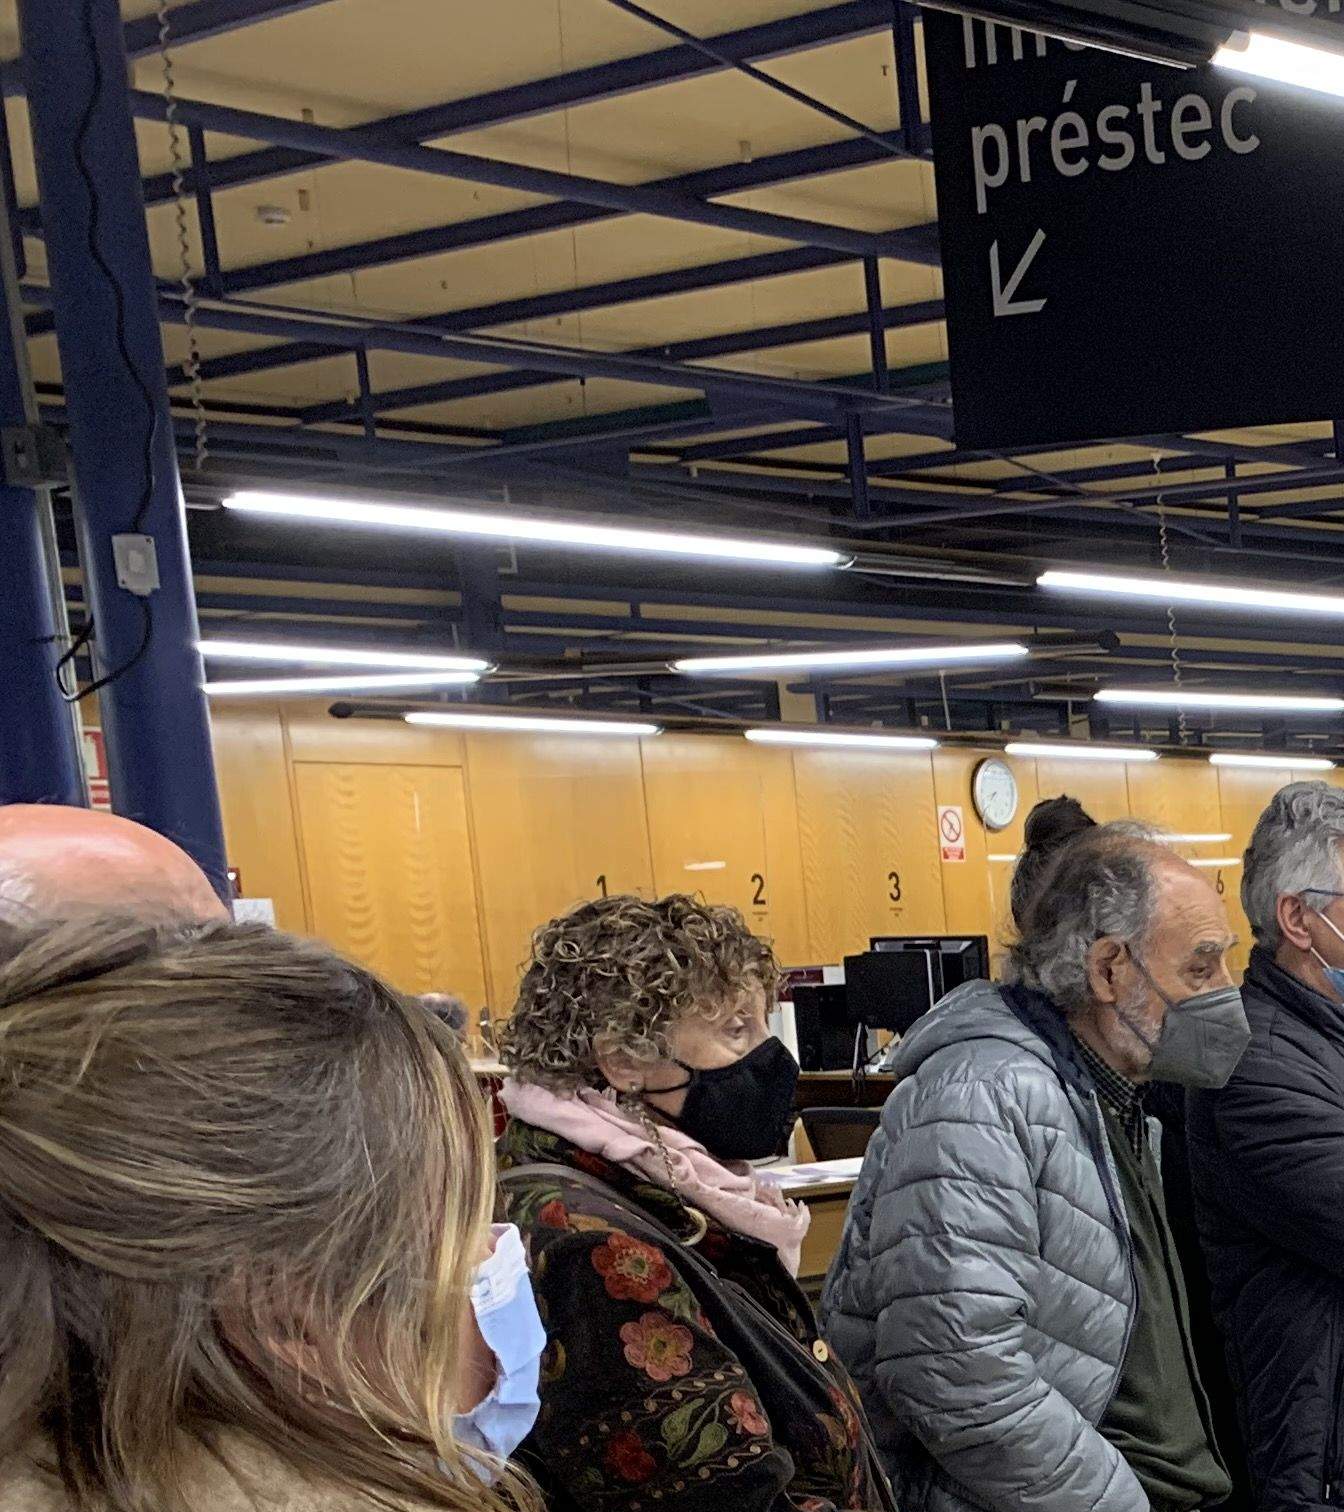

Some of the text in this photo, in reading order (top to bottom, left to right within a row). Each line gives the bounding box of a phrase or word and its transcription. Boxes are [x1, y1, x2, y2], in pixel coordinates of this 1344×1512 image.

[971, 80, 1261, 214] préstec
[751, 873, 766, 905] 2
[888, 872, 901, 903] 3
